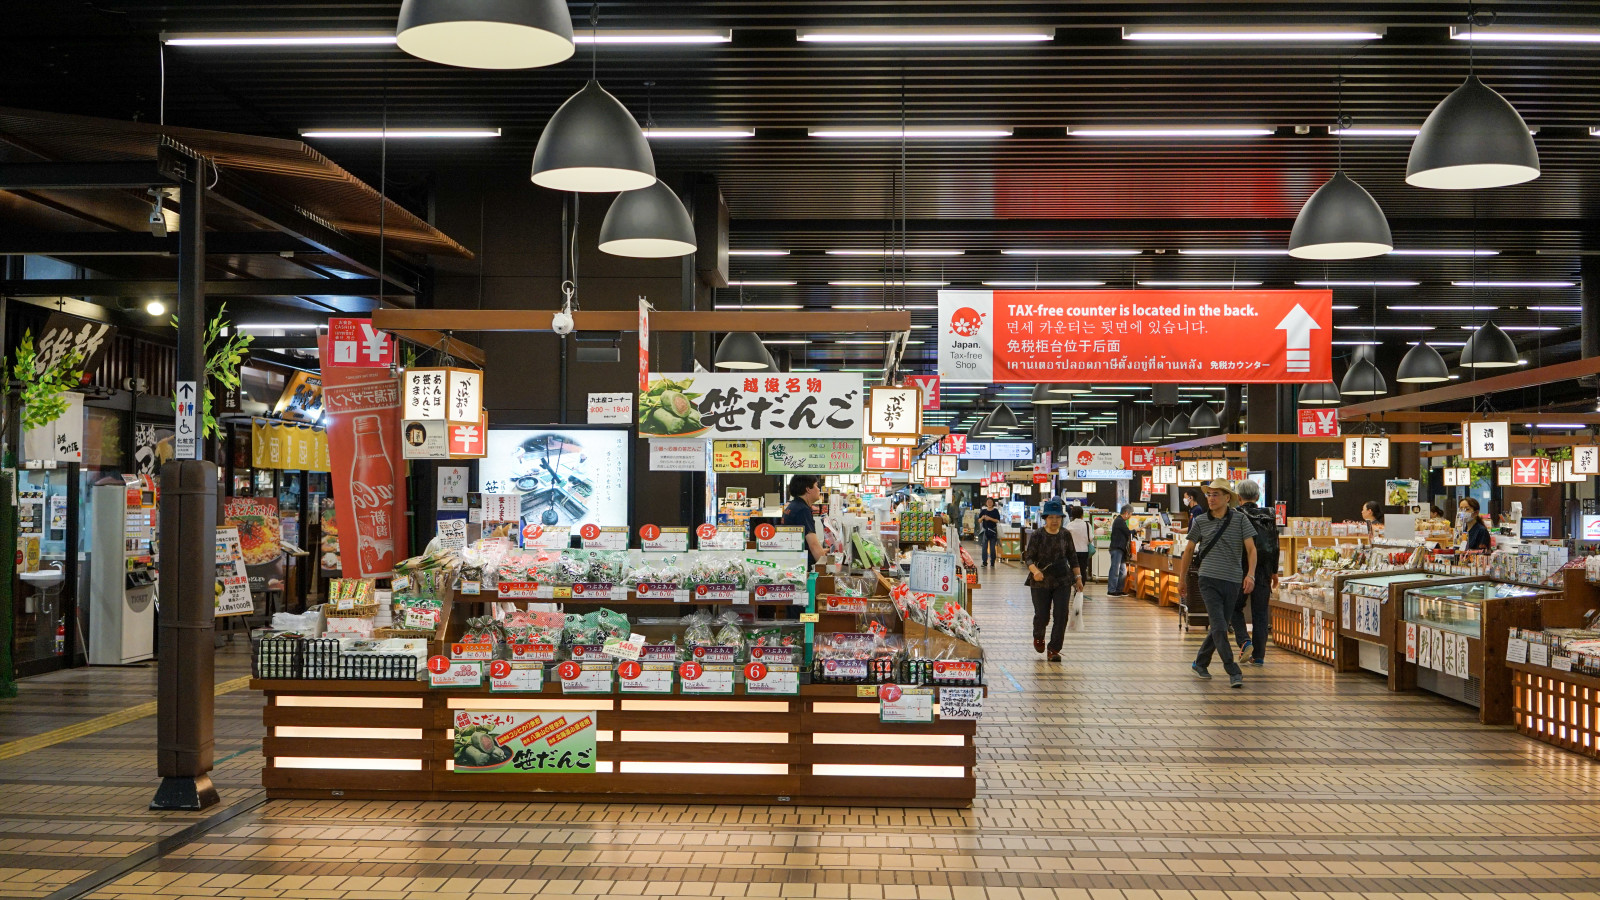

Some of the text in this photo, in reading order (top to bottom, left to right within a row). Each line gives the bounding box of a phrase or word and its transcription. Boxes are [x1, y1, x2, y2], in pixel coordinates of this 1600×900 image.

[1008, 304, 1258, 316] TAX-free counter is located in the back.
[1007, 320, 1208, 334] 면세 카운터는 뒷면에 있습니다.
[952, 341, 981, 350] Japan.
[1007, 339, 1121, 353] 免税柜台位于后面
[346, 345, 351, 359] 1
[950, 351, 982, 359] Tax-free
[955, 361, 977, 370] Shop
[1210, 361, 1270, 370] 免税カウンター
[743, 378, 822, 393] 越後名物
[698, 387, 858, 432] 笹だんご
[1316, 412, 1334, 433] ¥
[832, 441, 854, 450] 140円
[952, 435, 966, 452] ¥
[1484, 428, 1495, 452] 漬物
[830, 452, 854, 460] 670円
[1517, 459, 1536, 482] ¥
[586, 526, 594, 538] 3
[645, 527, 653, 539] 4
[702, 527, 712, 537] 5
[760, 527, 769, 538] 6
[618, 641, 638, 652] 140円
[1408, 626, 1414, 659] 名物
[436, 658, 441, 671] 1
[494, 664, 505, 676] 2
[564, 665, 573, 677] 3
[623, 665, 633, 677] 4
[686, 666, 696, 678] 5
[751, 666, 760, 678] 6
[886, 687, 895, 700] 7
[472, 714, 514, 727] こだわり
[512, 748, 592, 770] 笹だんご
